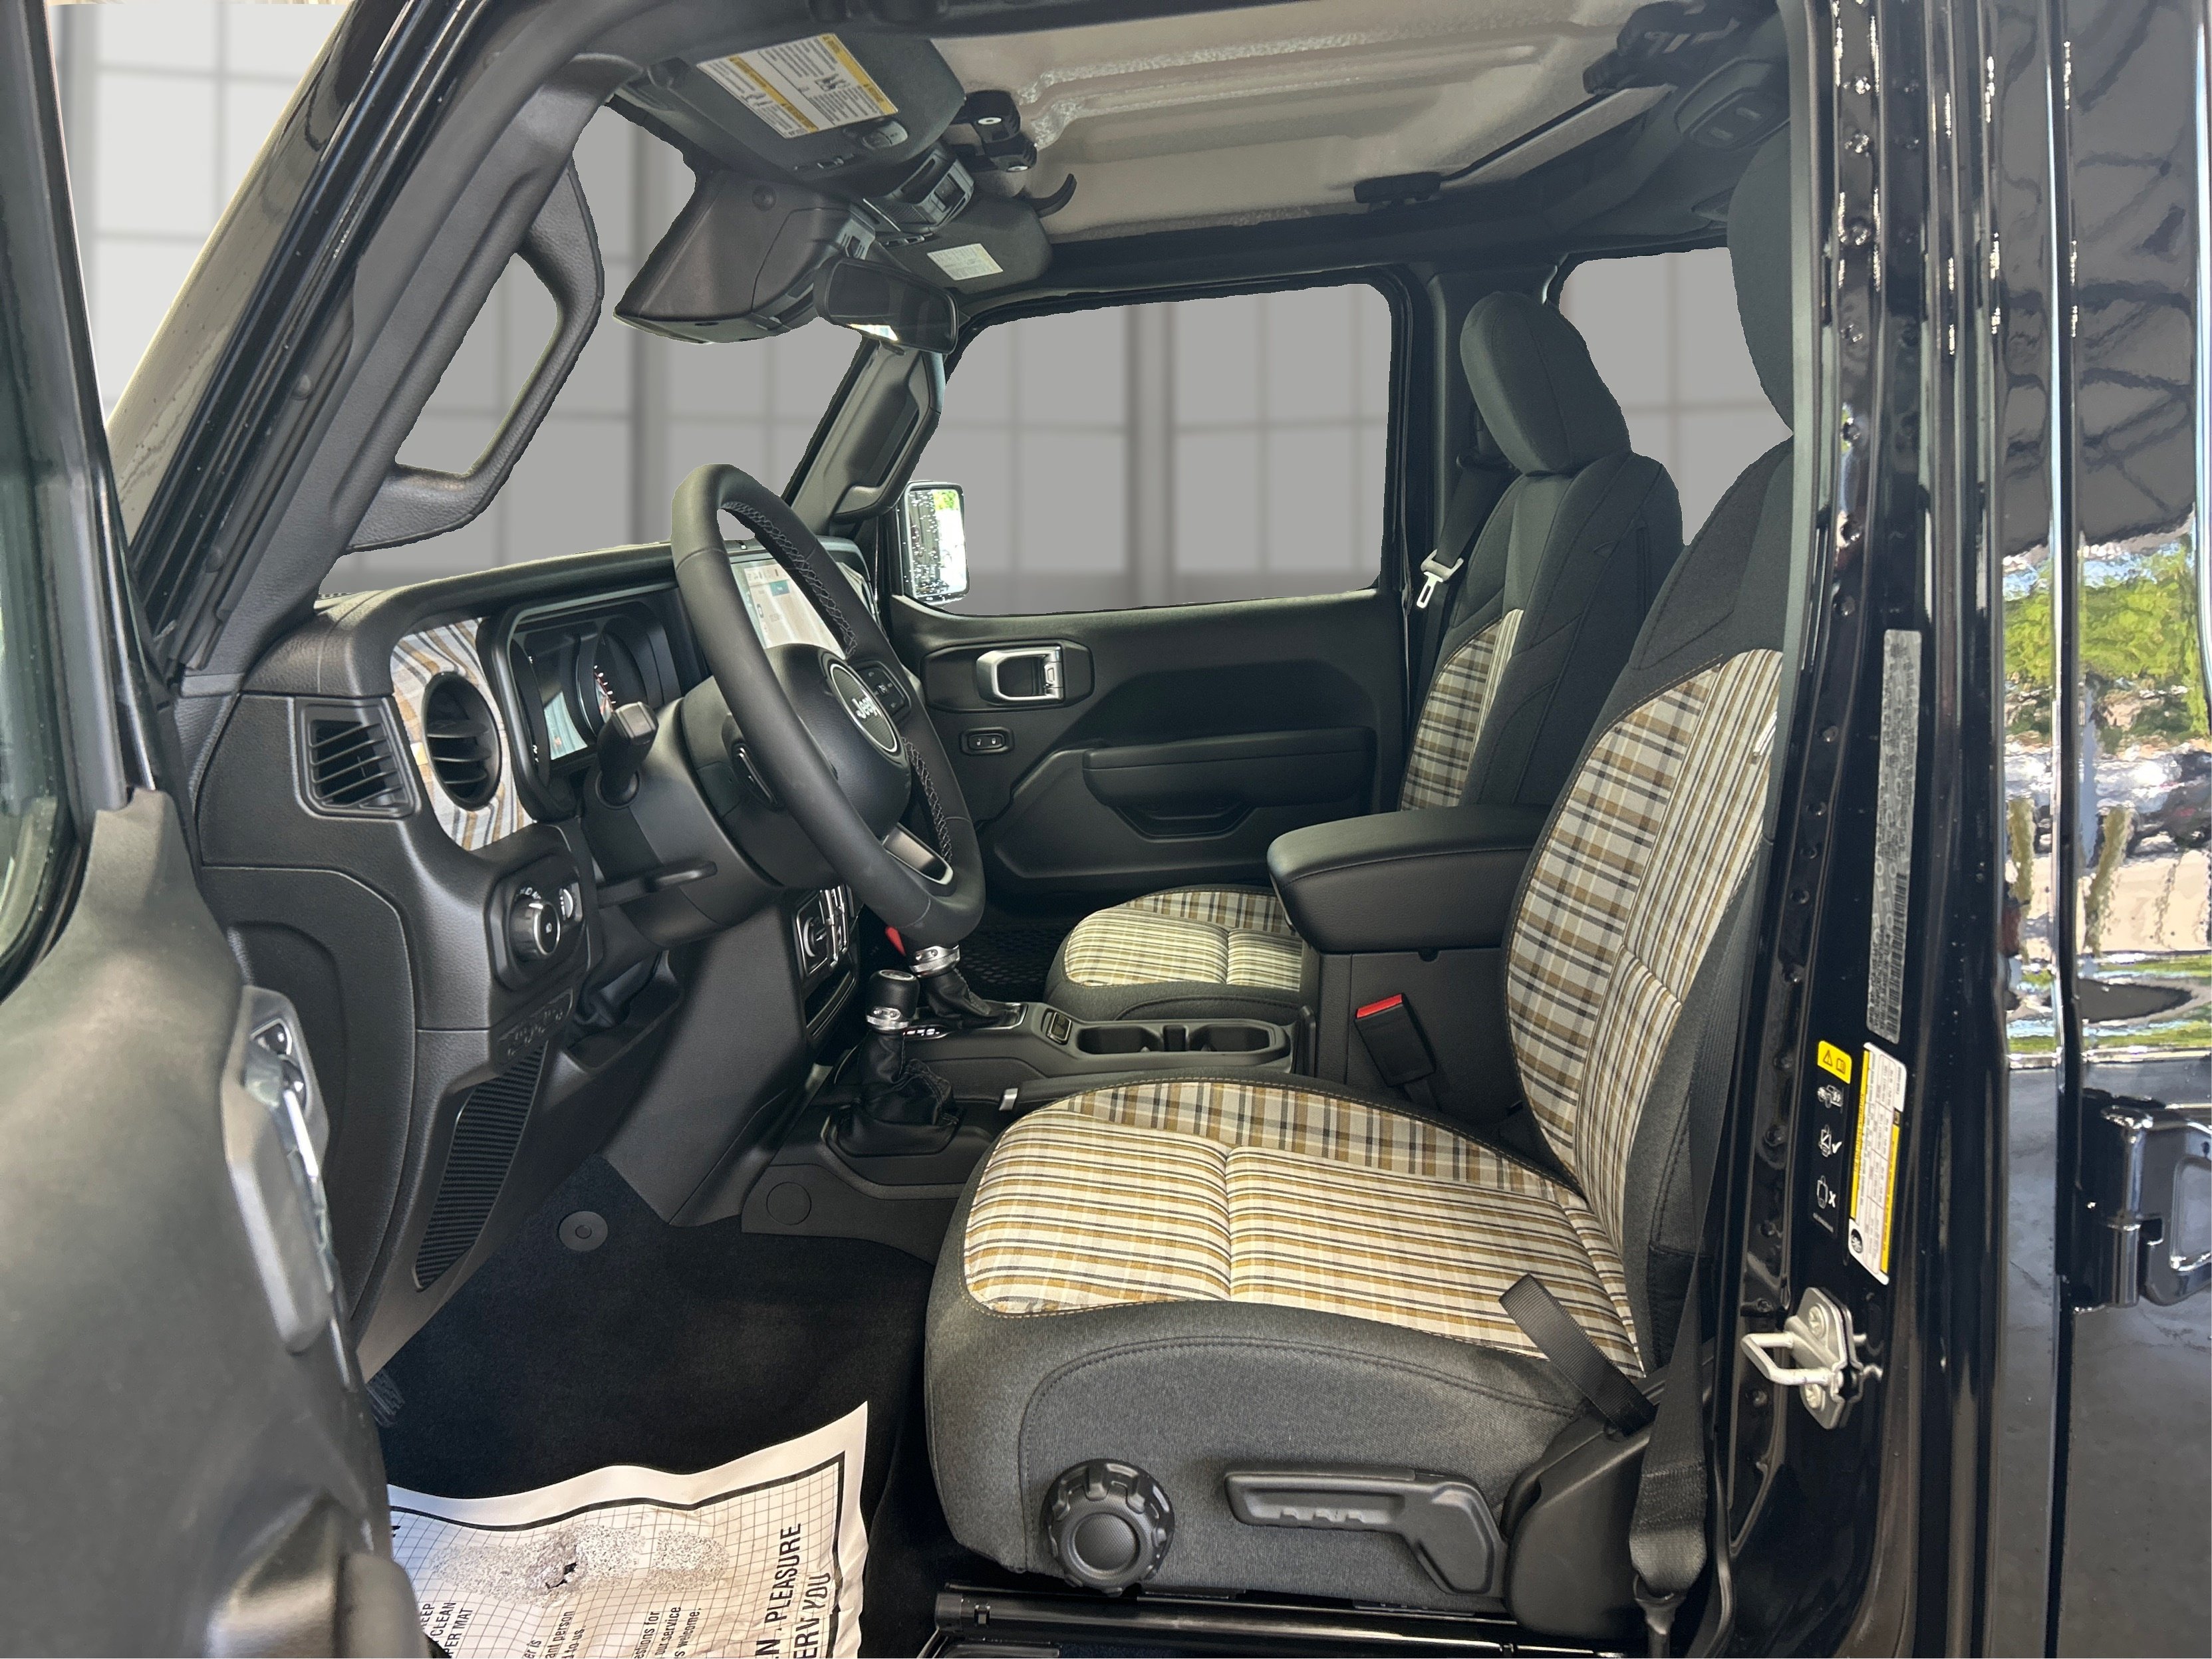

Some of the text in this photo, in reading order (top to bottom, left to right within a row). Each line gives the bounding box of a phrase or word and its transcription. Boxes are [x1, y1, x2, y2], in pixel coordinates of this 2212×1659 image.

[851, 698, 879, 719] Jeep
[763, 1523, 801, 1624] PLEASURE
[802, 1573, 831, 1610] YOU
[430, 1602, 457, 1636] CLEAN
[452, 1608, 474, 1628] MAT
[553, 1611, 575, 1642] person
[644, 1611, 660, 1625] for
[662, 1606, 681, 1641] service
[565, 1642, 580, 1654] to
[655, 1643, 670, 1656] our
